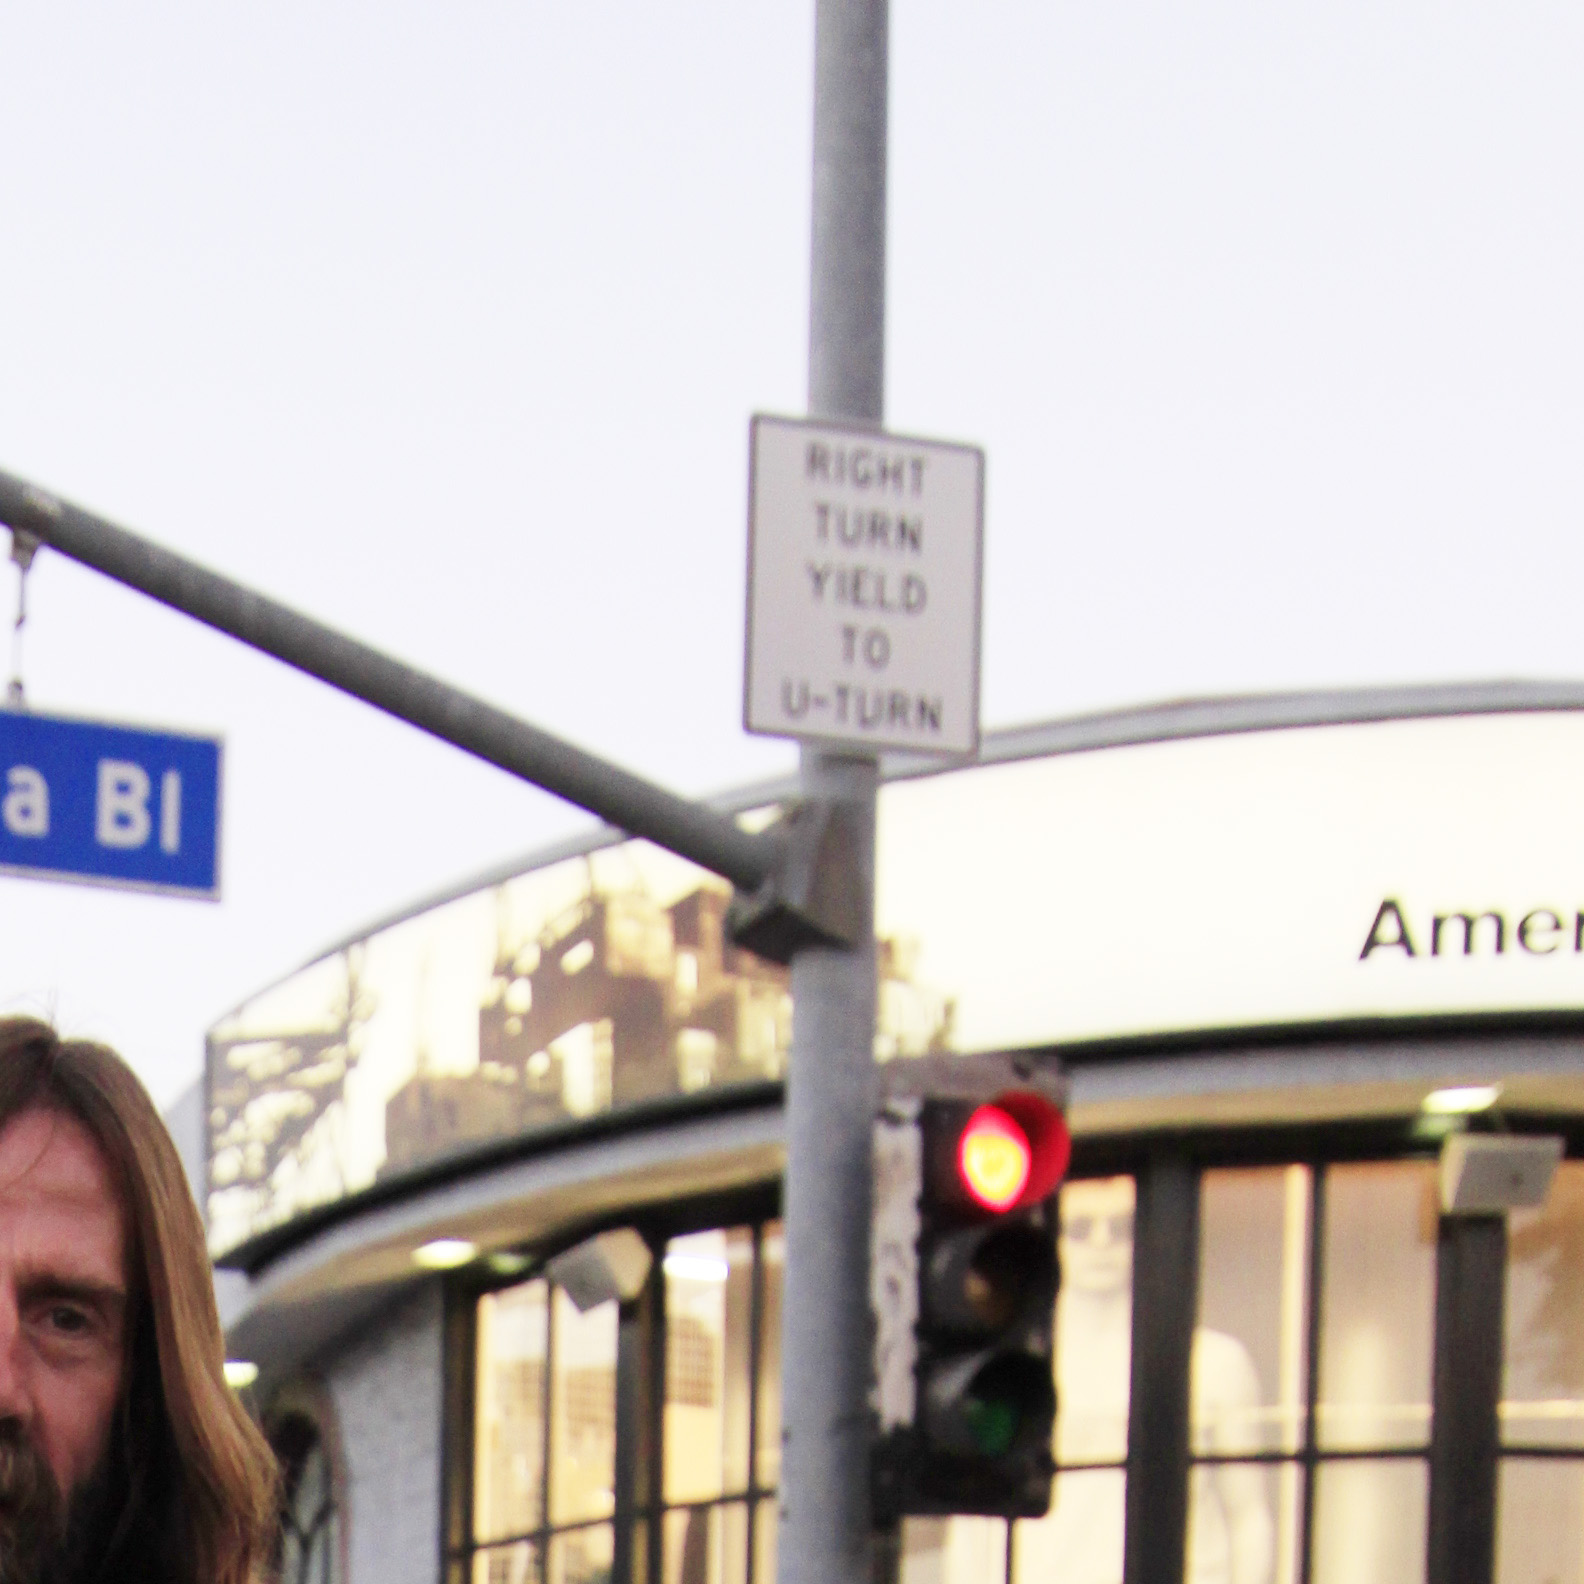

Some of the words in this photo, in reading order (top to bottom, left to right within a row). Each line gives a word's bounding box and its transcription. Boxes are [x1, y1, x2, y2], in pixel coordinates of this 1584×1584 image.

[805, 440, 926, 495] RIGHT
[815, 501, 923, 553] TURN
[806, 560, 928, 616] YIELD
[842, 624, 892, 671] TO
[781, 677, 944, 732] U-TURN
[94, 757, 182, 854] Bl
